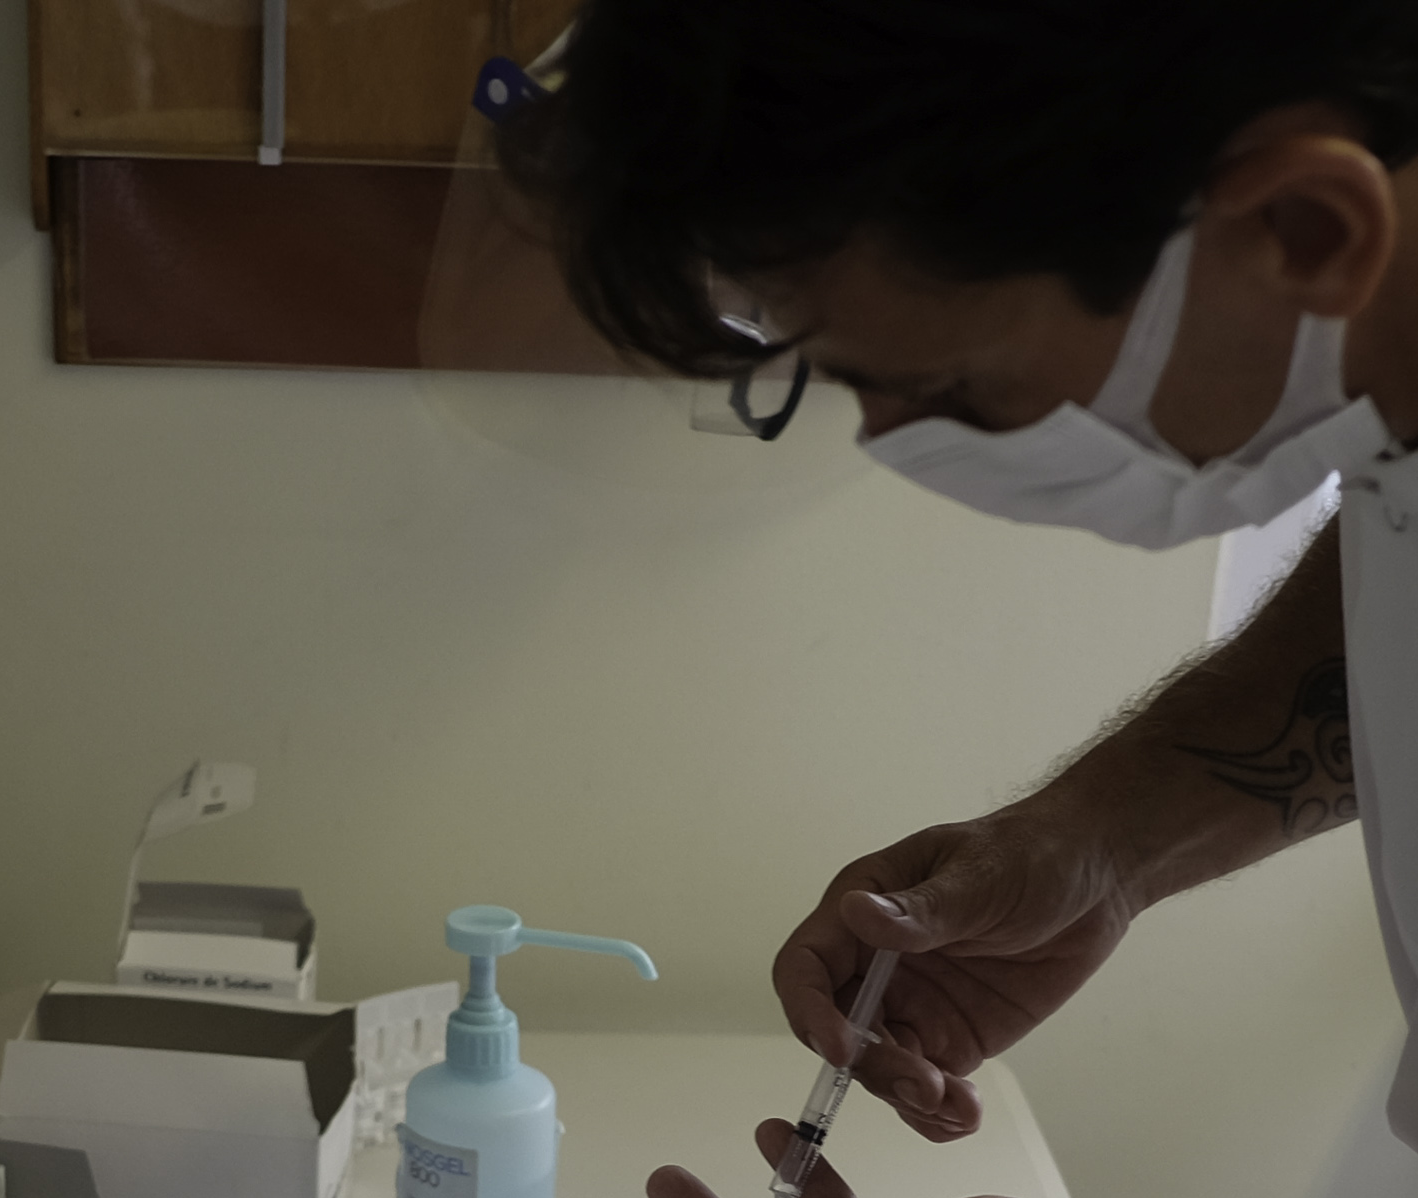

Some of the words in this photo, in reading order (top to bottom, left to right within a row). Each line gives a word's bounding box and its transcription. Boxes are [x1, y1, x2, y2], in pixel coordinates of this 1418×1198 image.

[203, 974, 218, 987] de
[224, 976, 273, 991] Sodium
[409, 1160, 441, 1188] 800
